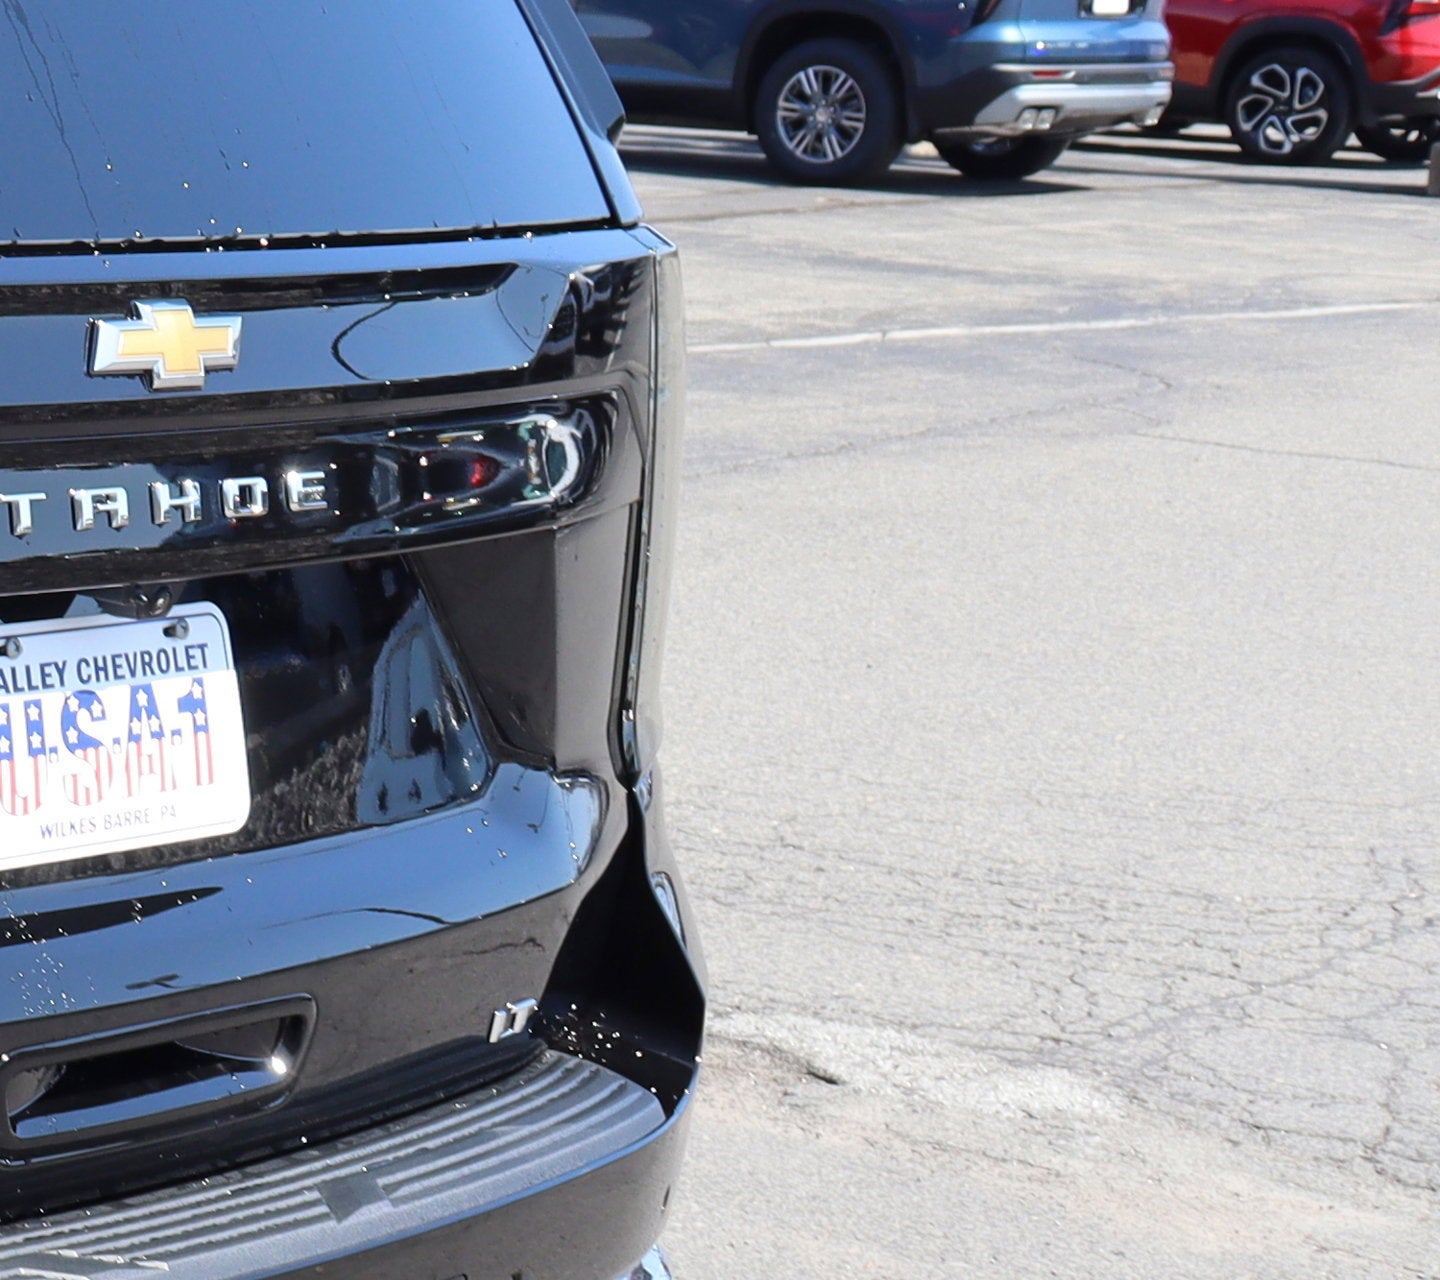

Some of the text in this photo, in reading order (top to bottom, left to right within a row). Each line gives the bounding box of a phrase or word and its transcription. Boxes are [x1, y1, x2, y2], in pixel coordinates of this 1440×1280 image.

[76, 642, 209, 685] CHEVROLET
[40, 803, 177, 840] WILKES BARRE PA
[488, 997, 538, 1043] LT
